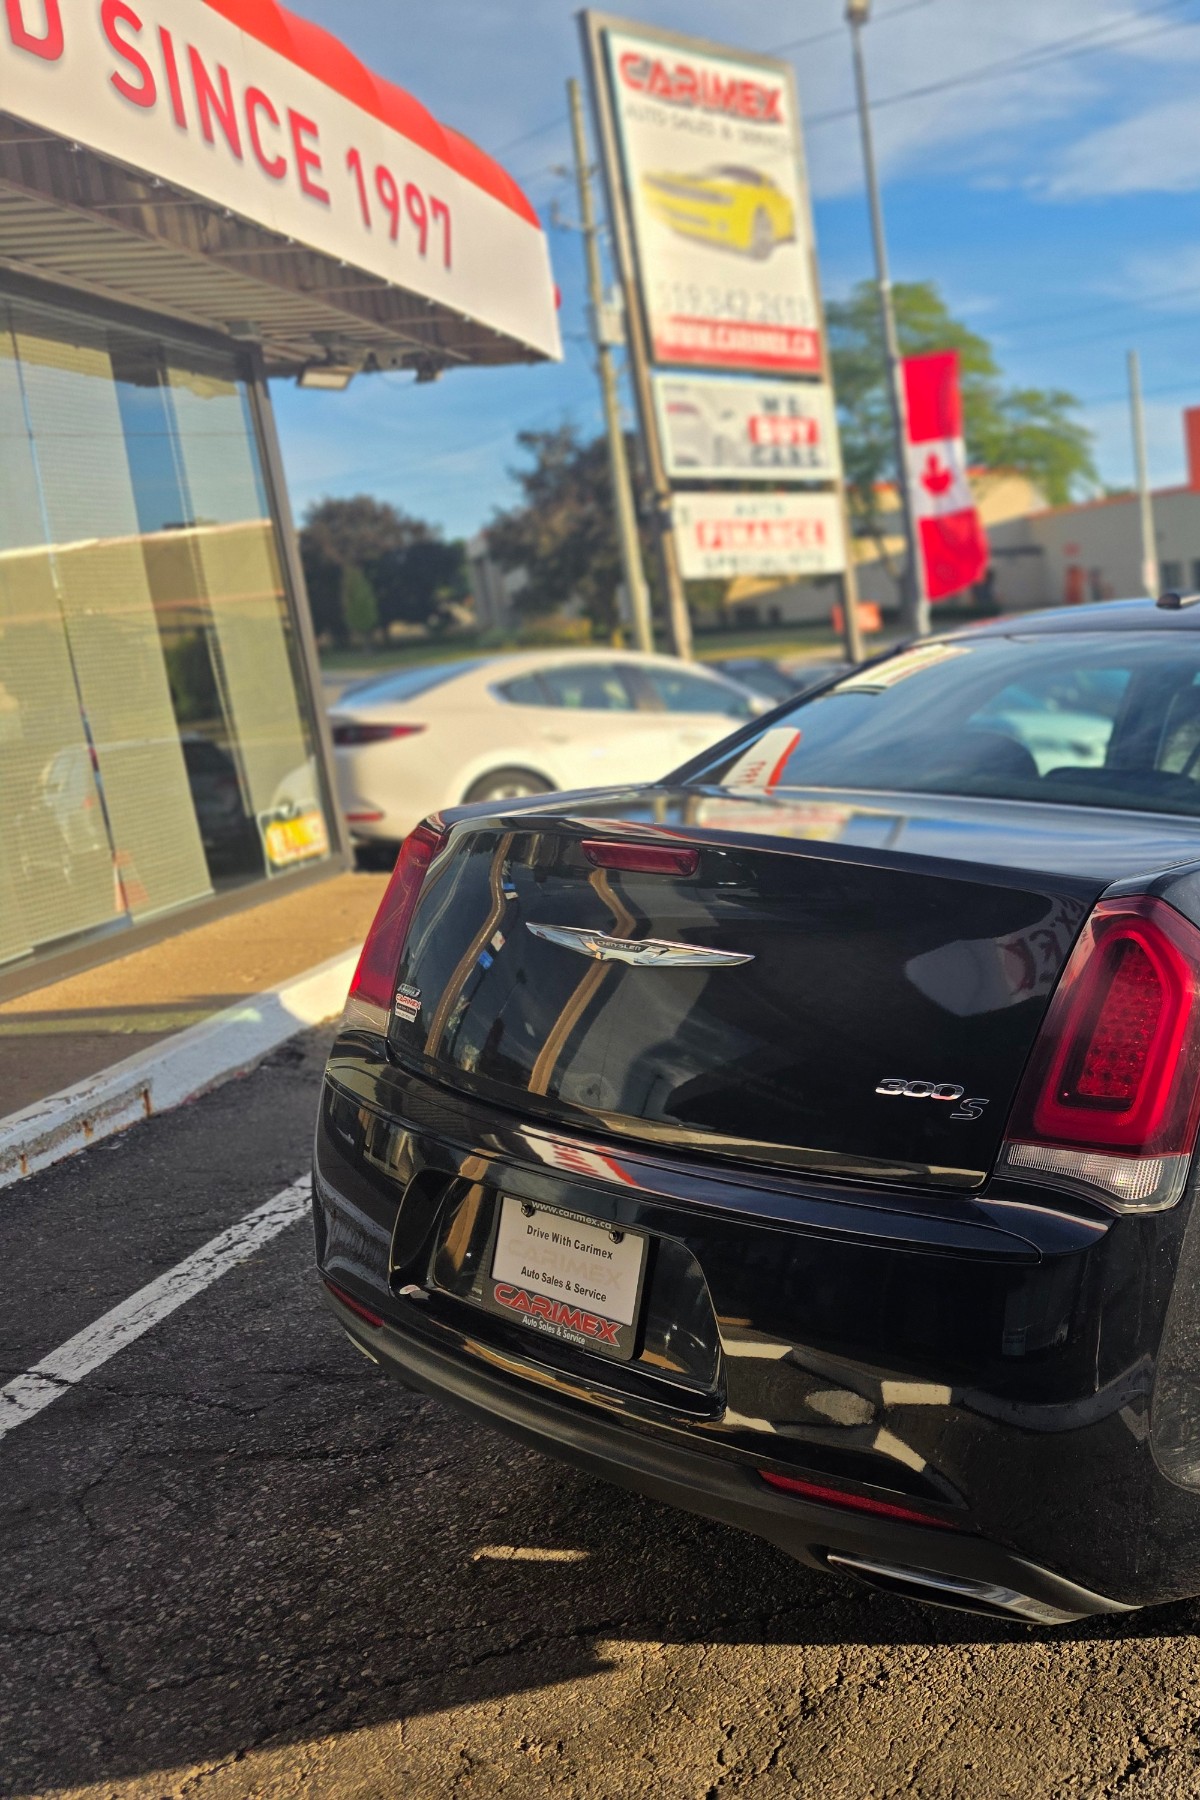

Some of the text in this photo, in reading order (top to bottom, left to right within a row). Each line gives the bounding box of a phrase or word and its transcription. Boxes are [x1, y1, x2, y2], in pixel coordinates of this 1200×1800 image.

[619, 52, 783, 124] CARIMEX
[101, 0, 330, 205] SINCE
[347, 147, 452, 270] 1997
[597, 940, 642, 951] CHRYSLER
[875, 1078, 965, 1101] 300
[531, 1200, 612, 1230] www.carimex.ca
[526, 1224, 613, 1260] Drive With Carimex
[520, 1265, 607, 1302] Auto Sales & Service
[493, 1282, 623, 1347] CARIMEX
[521, 1315, 538, 1327] Auto
[562, 1329, 586, 1345] Service
